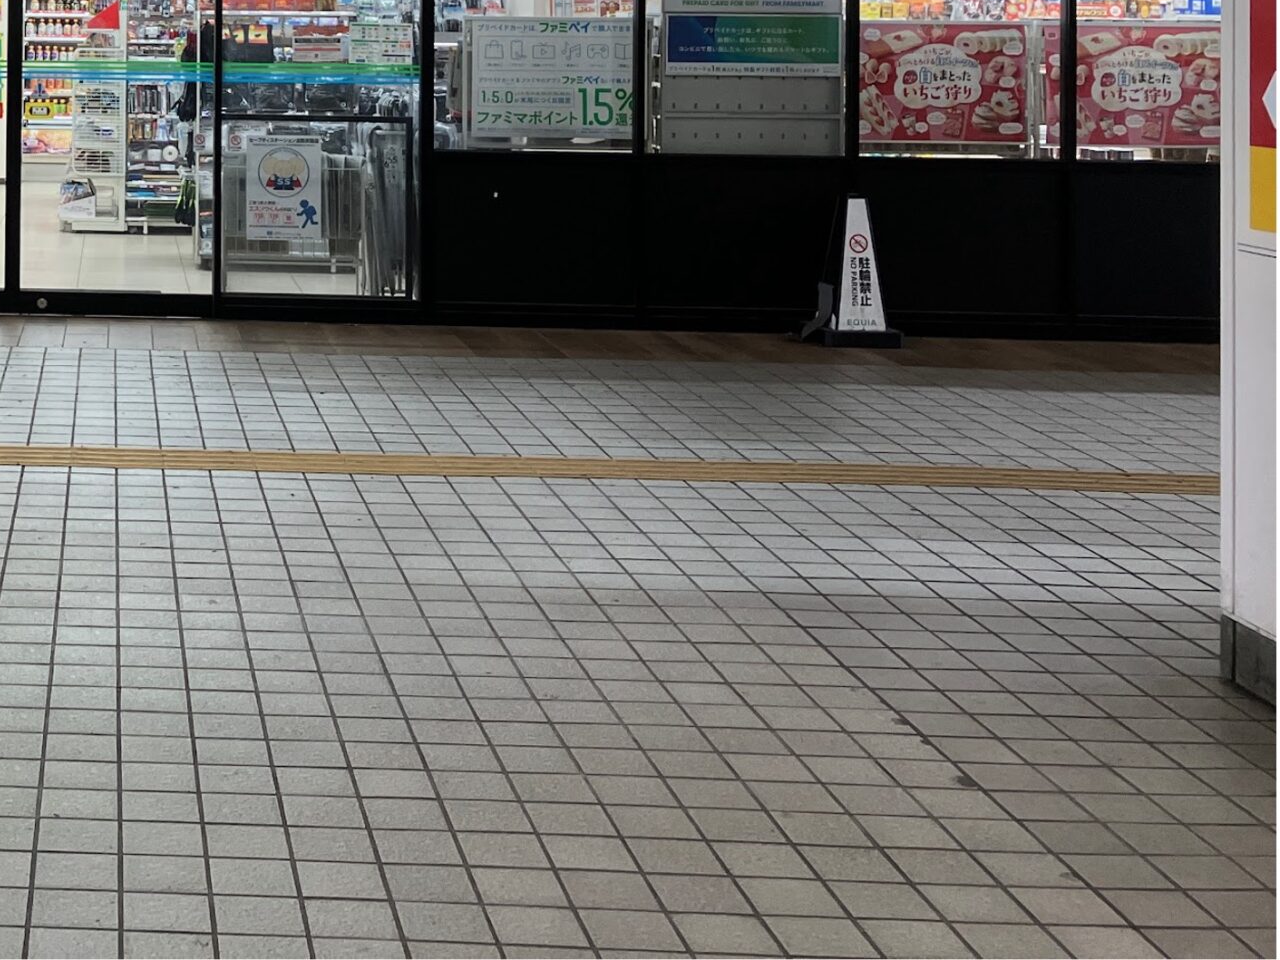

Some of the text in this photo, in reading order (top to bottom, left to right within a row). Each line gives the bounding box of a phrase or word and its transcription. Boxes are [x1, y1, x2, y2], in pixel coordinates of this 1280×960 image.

[538, 22, 591, 33] ファミペイ
[561, 75, 601, 85] ファミペイ
[903, 84, 973, 101] いちご狩り
[1100, 87, 1172, 104] いちご狩り
[477, 110, 578, 126] ファミマポイント
[850, 257, 857, 269] NO
